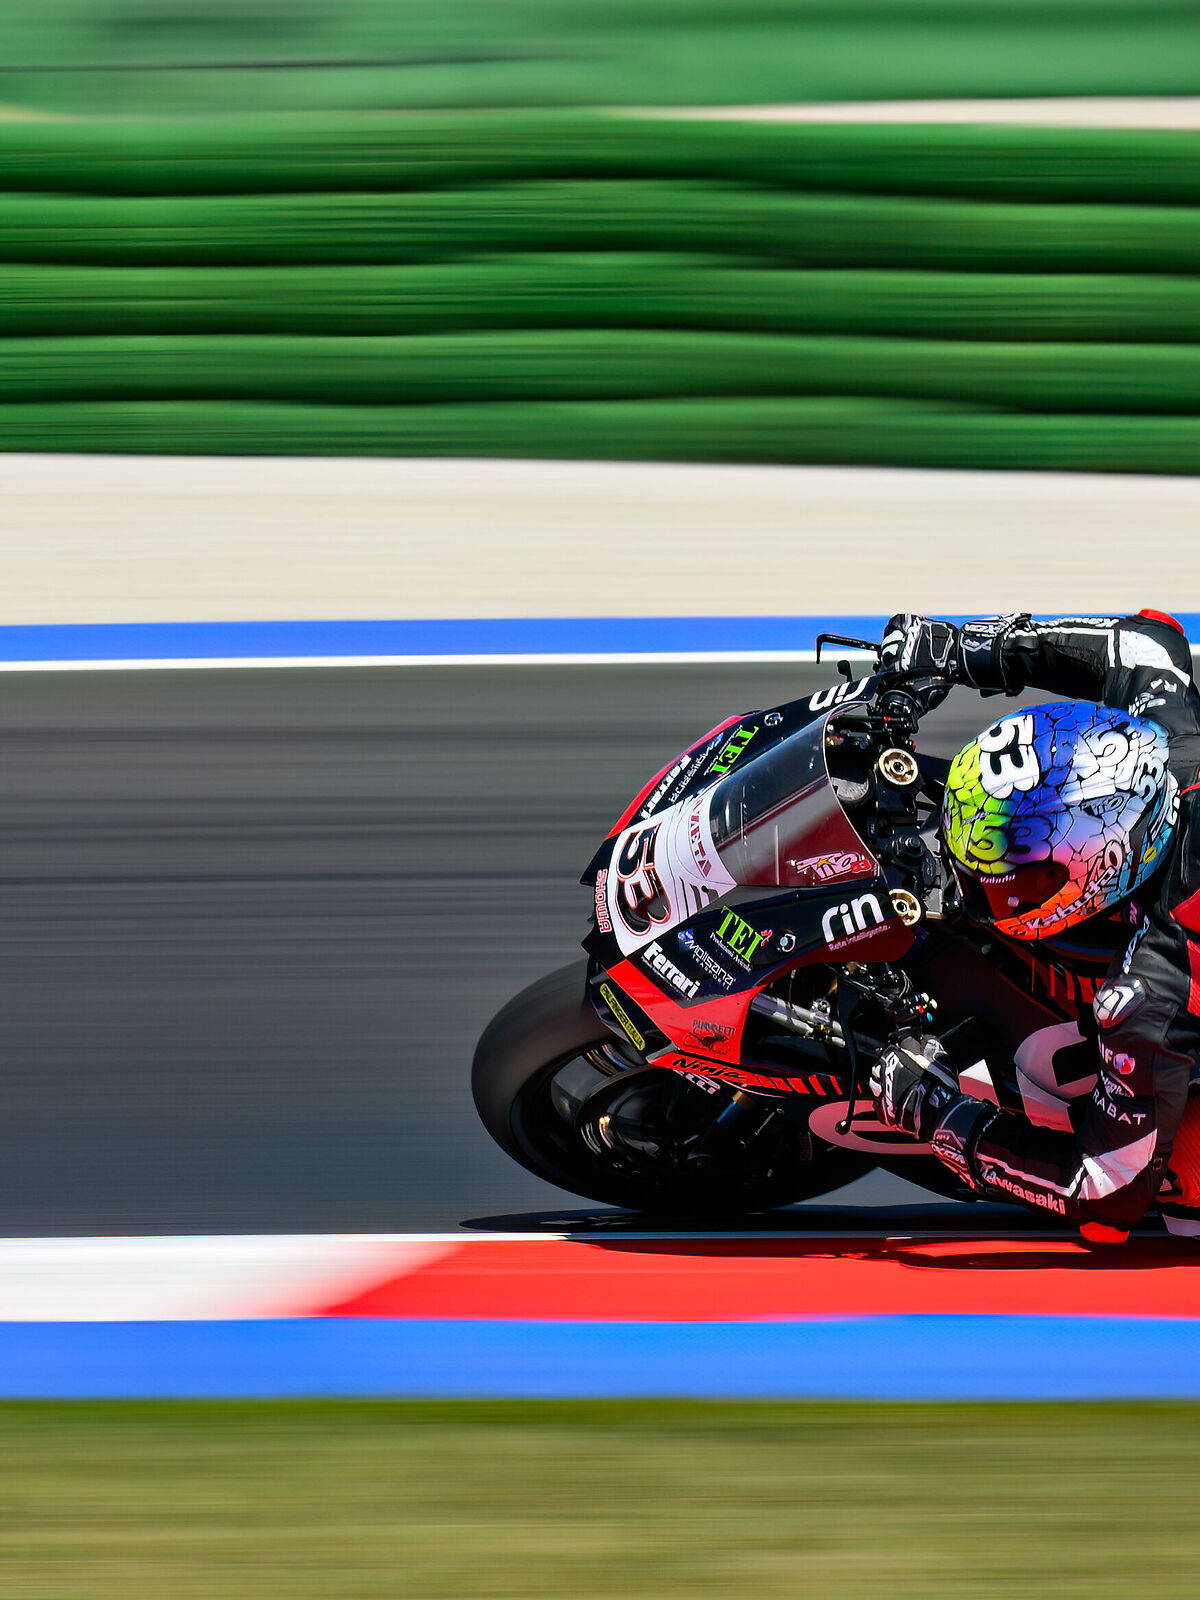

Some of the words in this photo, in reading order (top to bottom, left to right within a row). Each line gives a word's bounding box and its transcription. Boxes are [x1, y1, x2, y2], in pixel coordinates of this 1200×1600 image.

[809, 677, 869, 711] rin
[709, 725, 760, 774] TEI
[978, 714, 1040, 800] 53
[966, 815, 1053, 866] 53
[594, 868, 612, 933] SHOWA
[614, 820, 672, 937] 53
[716, 905, 763, 963] TEI
[822, 893, 885, 943] rin
[643, 941, 700, 999] Ferrari
[672, 1057, 747, 1080] Ninja
[1092, 1087, 1147, 1126] RABAT
